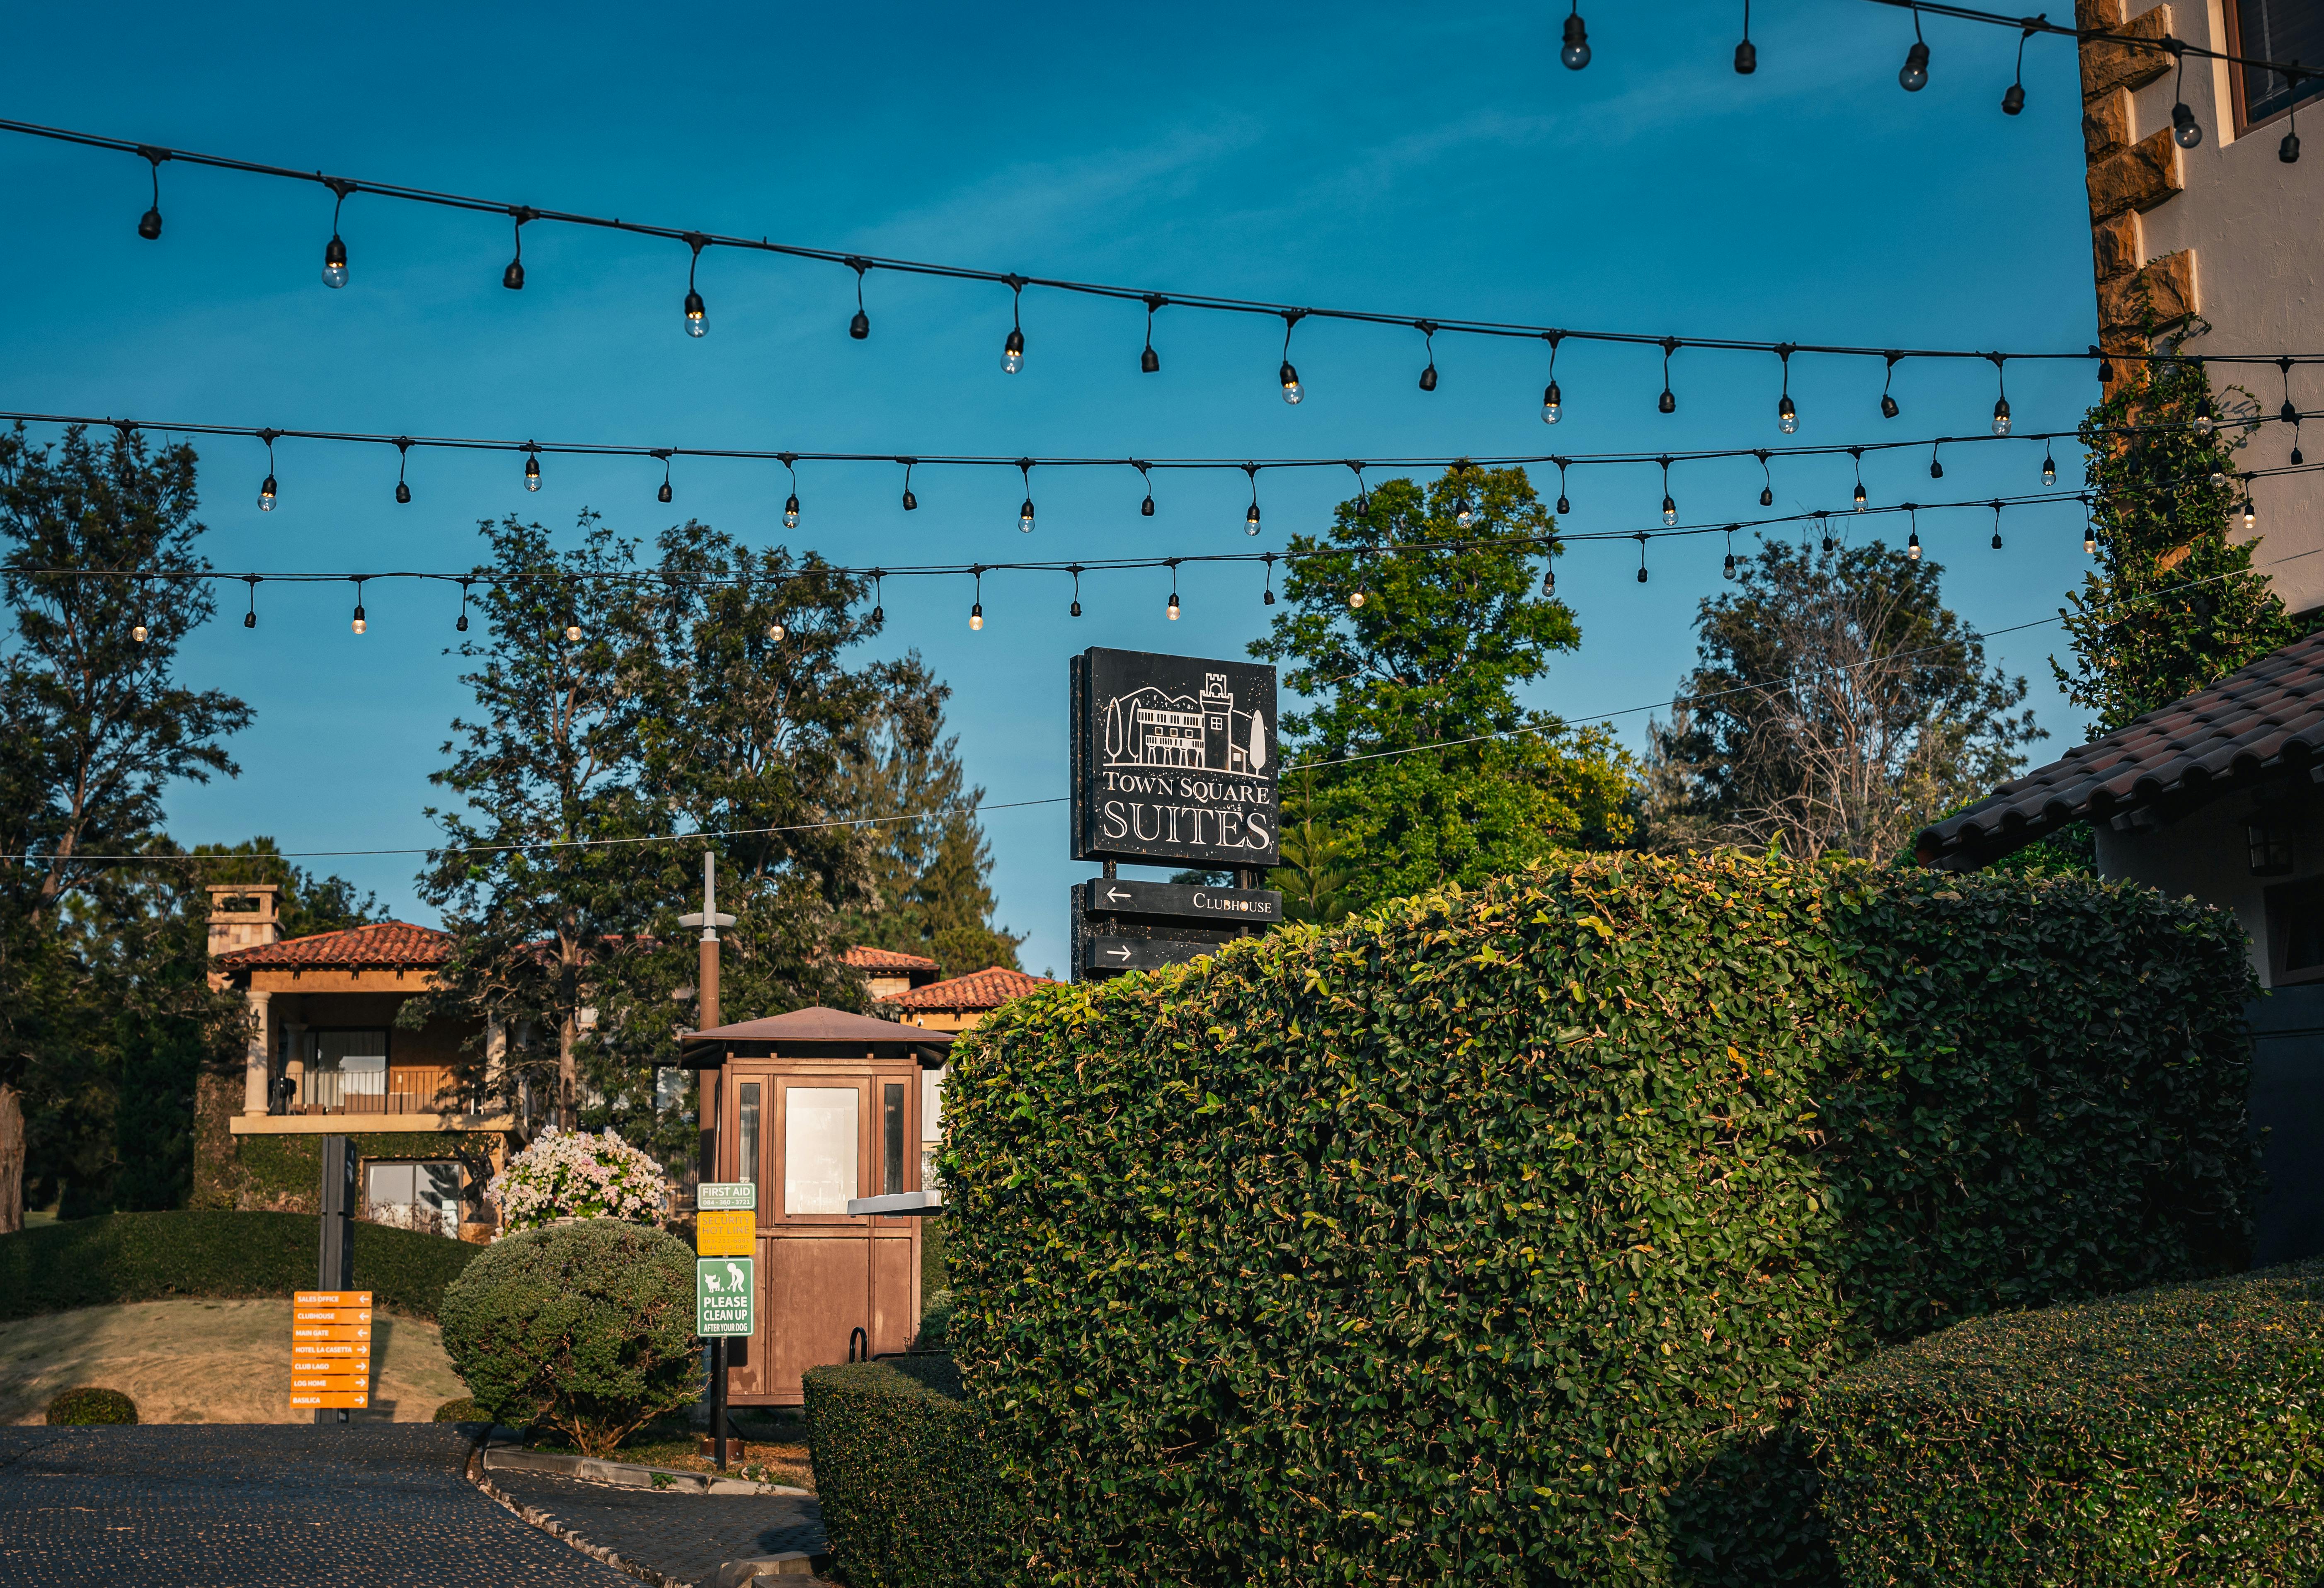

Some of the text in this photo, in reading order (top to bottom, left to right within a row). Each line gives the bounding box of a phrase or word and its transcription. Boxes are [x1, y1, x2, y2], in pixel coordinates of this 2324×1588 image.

[1103, 771, 1270, 805] TOWN SQUARE
[1103, 800, 1270, 850] SUITES
[703, 1186, 751, 1196] FIRST AID
[702, 1216, 750, 1225] SECURITY
[702, 1226, 750, 1235] HOT LINE
[704, 1296, 748, 1308] PLEASE
[703, 1309, 748, 1321] CLEAN UP
[704, 1323, 748, 1332] AFTER YOUR DOG
